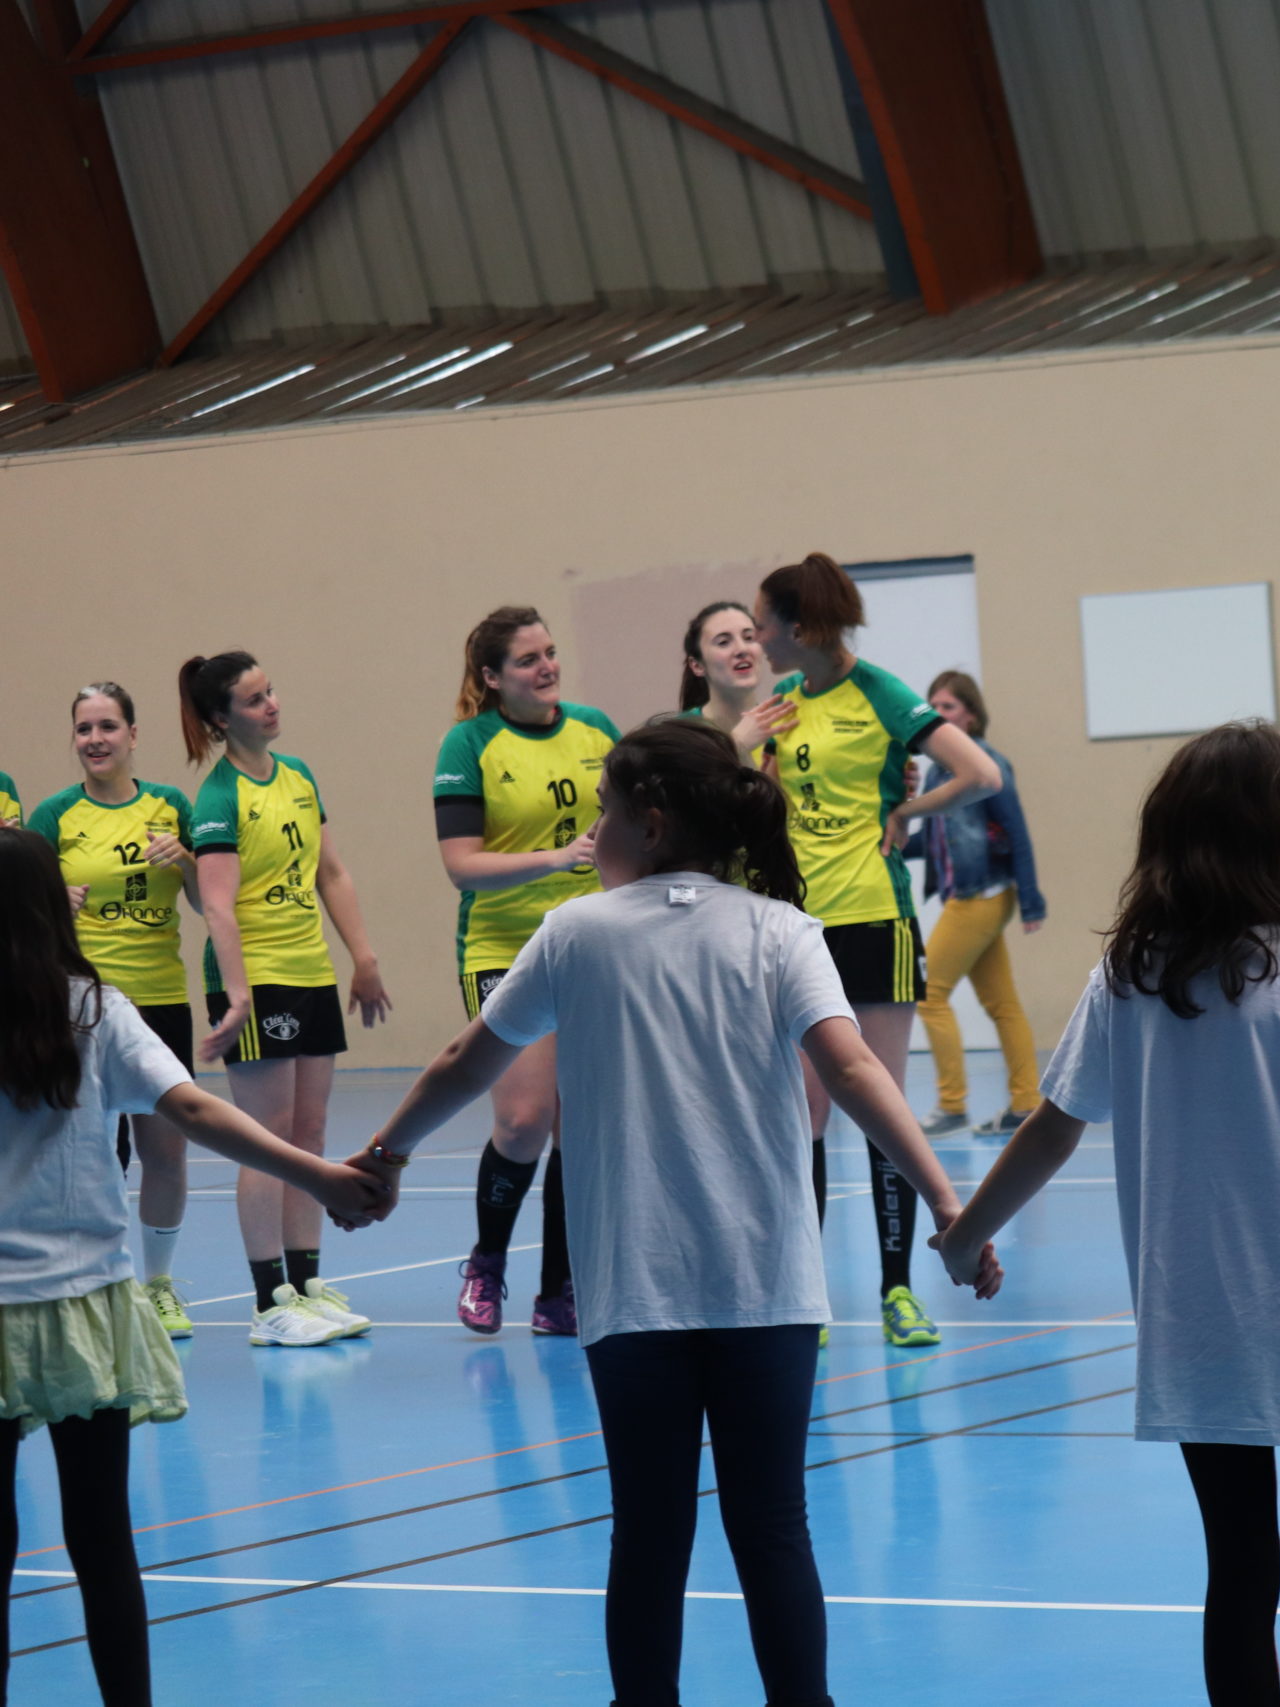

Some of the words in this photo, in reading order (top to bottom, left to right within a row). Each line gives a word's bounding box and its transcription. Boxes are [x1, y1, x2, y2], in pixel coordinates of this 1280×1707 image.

[796, 743, 811, 772] 8
[547, 778, 578, 810] 10
[281, 820, 304, 851] 11
[113, 841, 146, 866] 12
